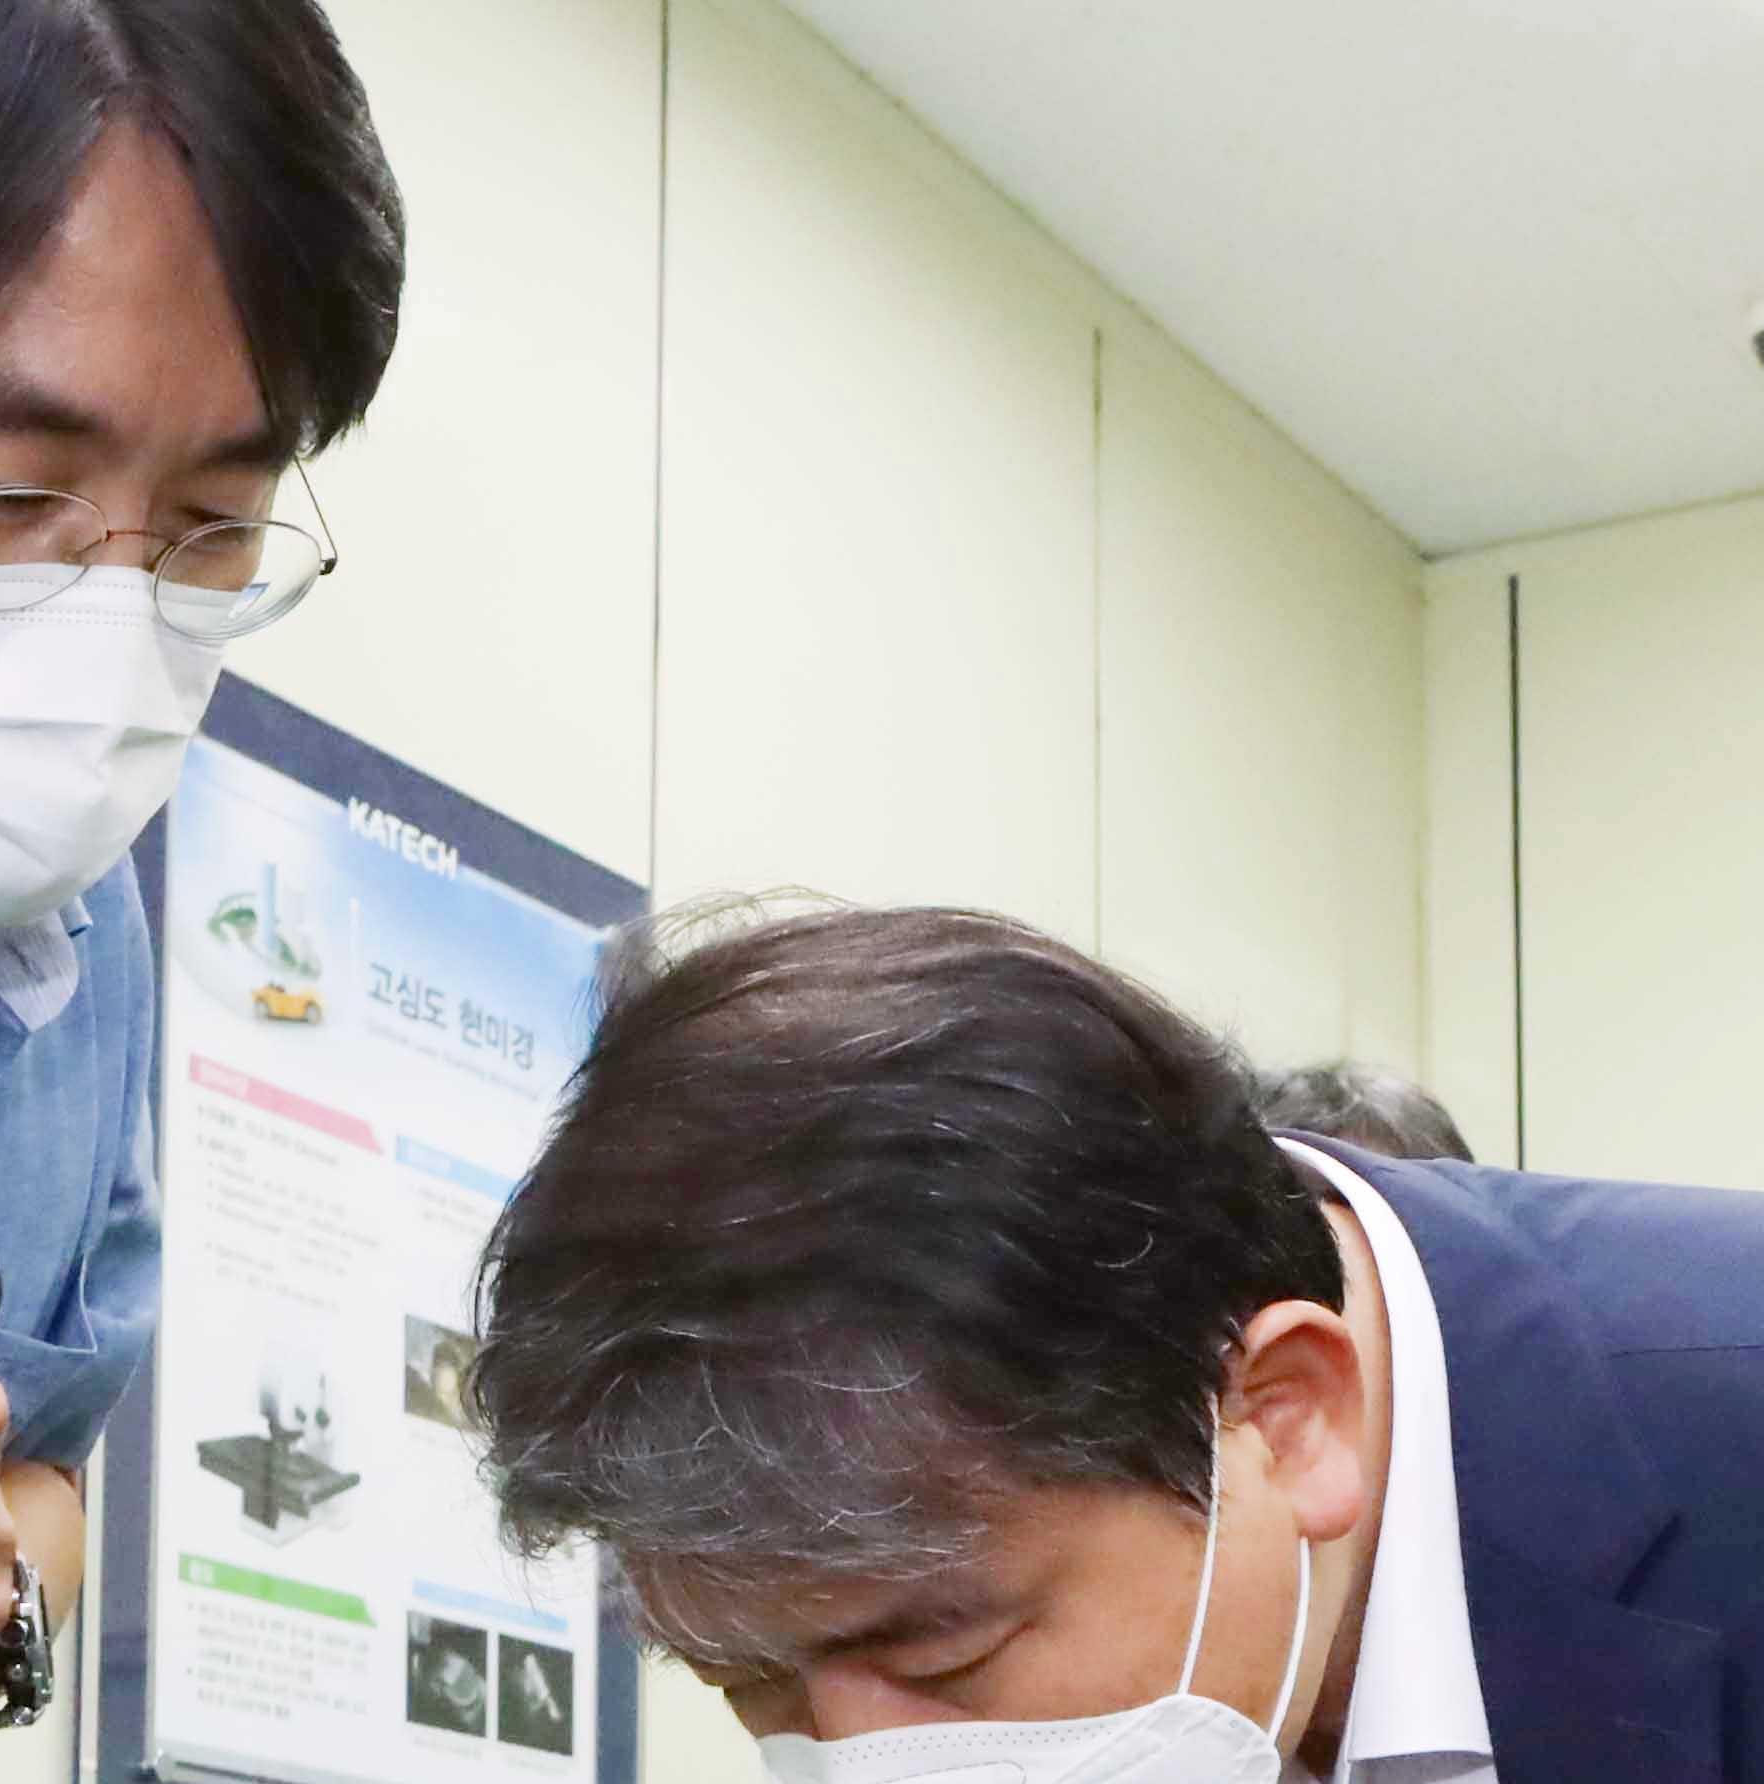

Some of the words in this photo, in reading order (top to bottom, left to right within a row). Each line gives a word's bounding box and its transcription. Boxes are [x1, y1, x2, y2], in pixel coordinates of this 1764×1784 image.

[348, 797, 458, 880] KATECH
[367, 962, 449, 1031] 고심도
[457, 997, 535, 1071] 현미경
